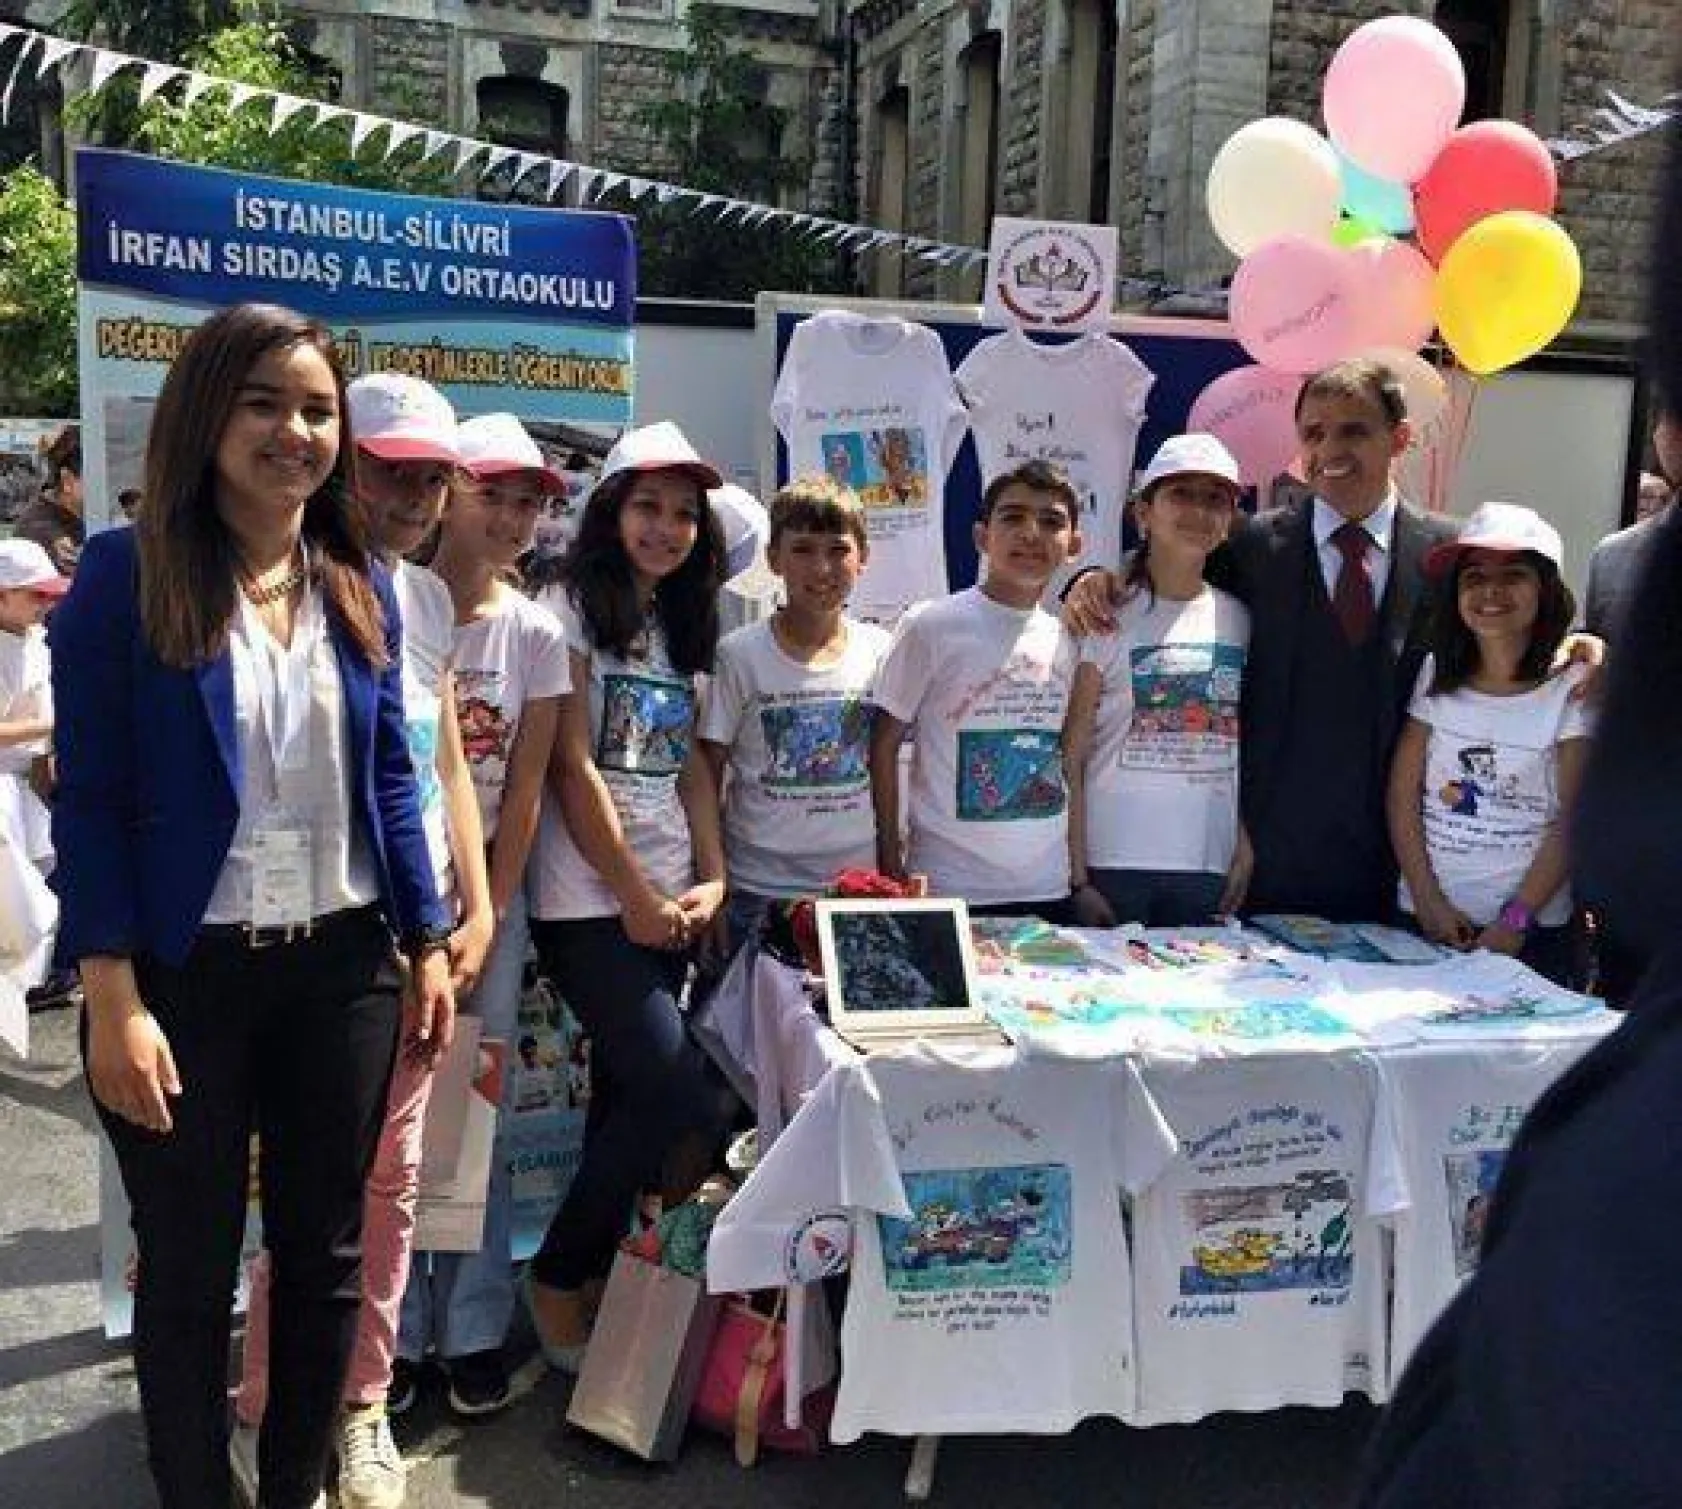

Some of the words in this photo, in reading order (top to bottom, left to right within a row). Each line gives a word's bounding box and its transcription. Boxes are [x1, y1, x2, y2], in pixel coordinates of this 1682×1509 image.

[235, 187, 511, 257] İSTANBUL-SİLİVRİ
[108, 220, 212, 273] İRFAN
[223, 243, 342, 292] SIRDAŞ
[351, 261, 427, 292] A.E.V
[440, 269, 615, 311] ORTAOKULU
